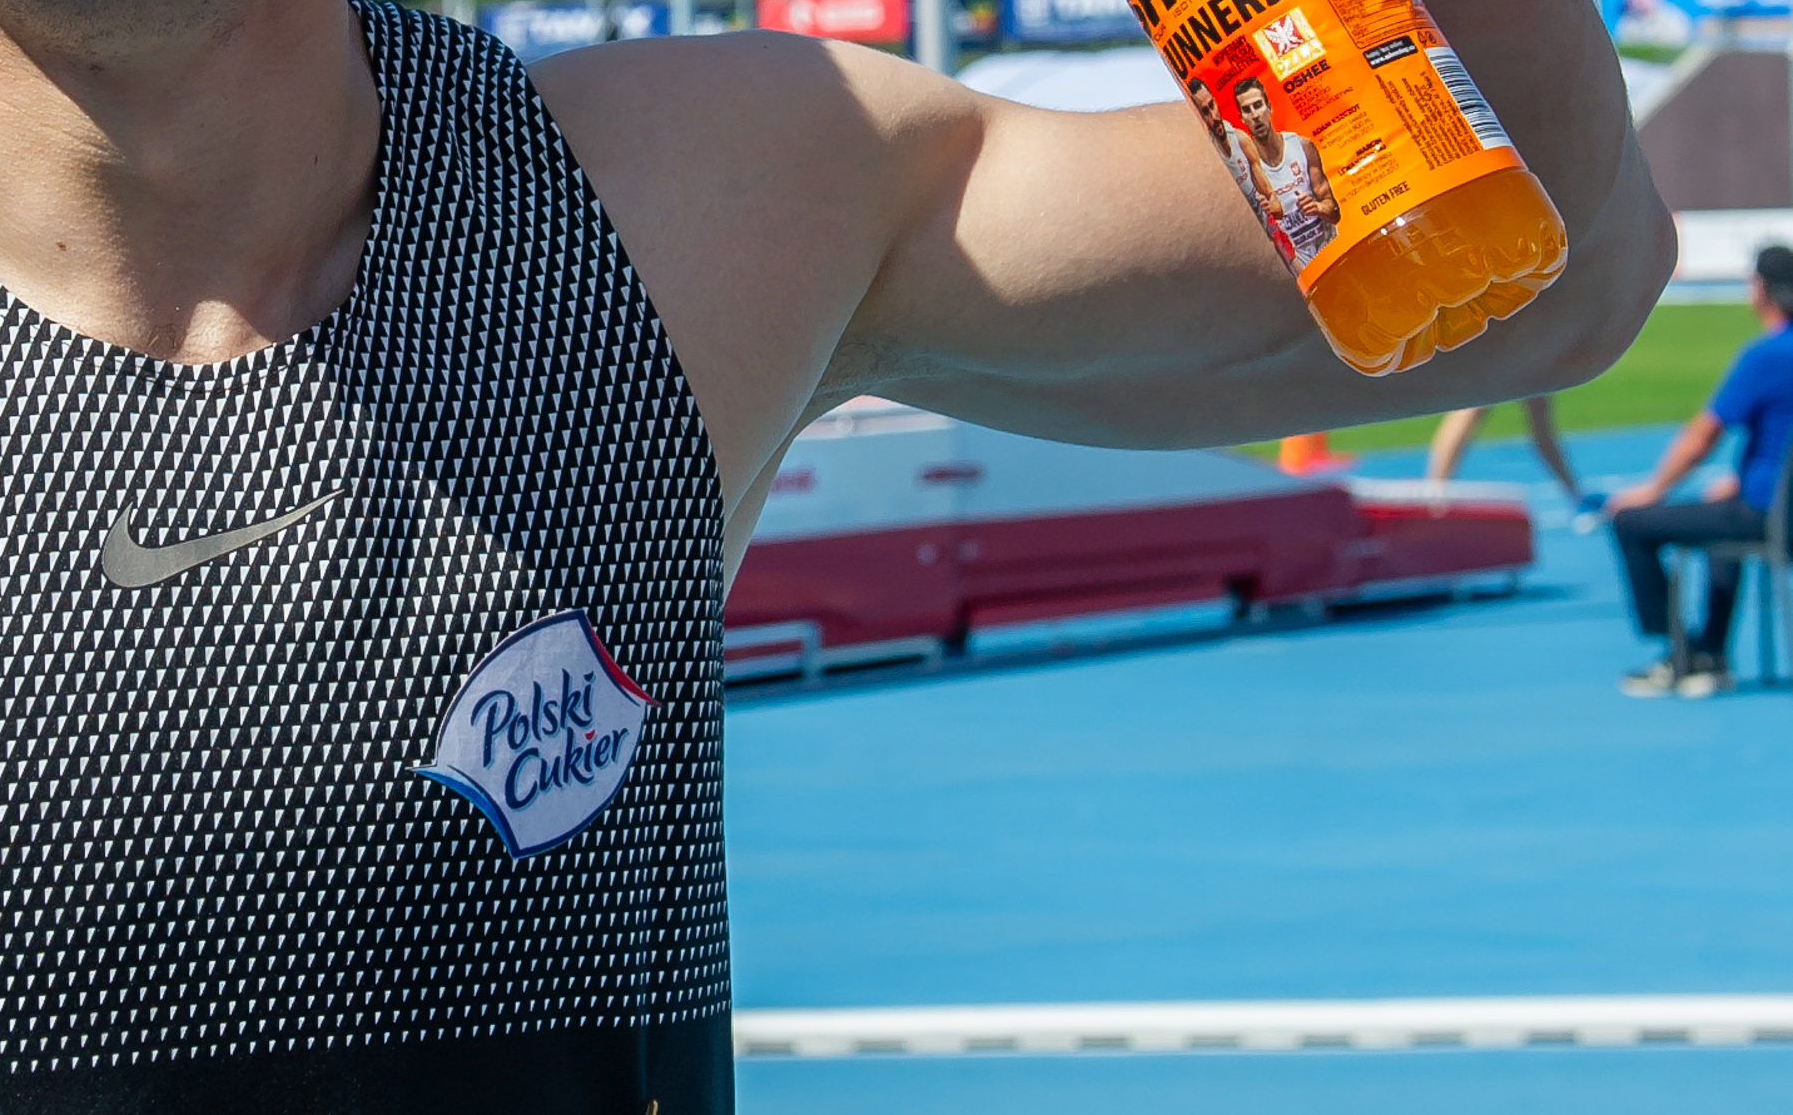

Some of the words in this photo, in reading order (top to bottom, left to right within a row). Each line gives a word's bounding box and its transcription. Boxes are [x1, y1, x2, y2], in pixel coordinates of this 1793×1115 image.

[1283, 59, 1331, 93] OSHEE
[1361, 192, 1390, 215] GLUTEN
[1389, 180, 1409, 198] FREE
[471, 668, 595, 768] Polski
[505, 727, 629, 811] Cukier
